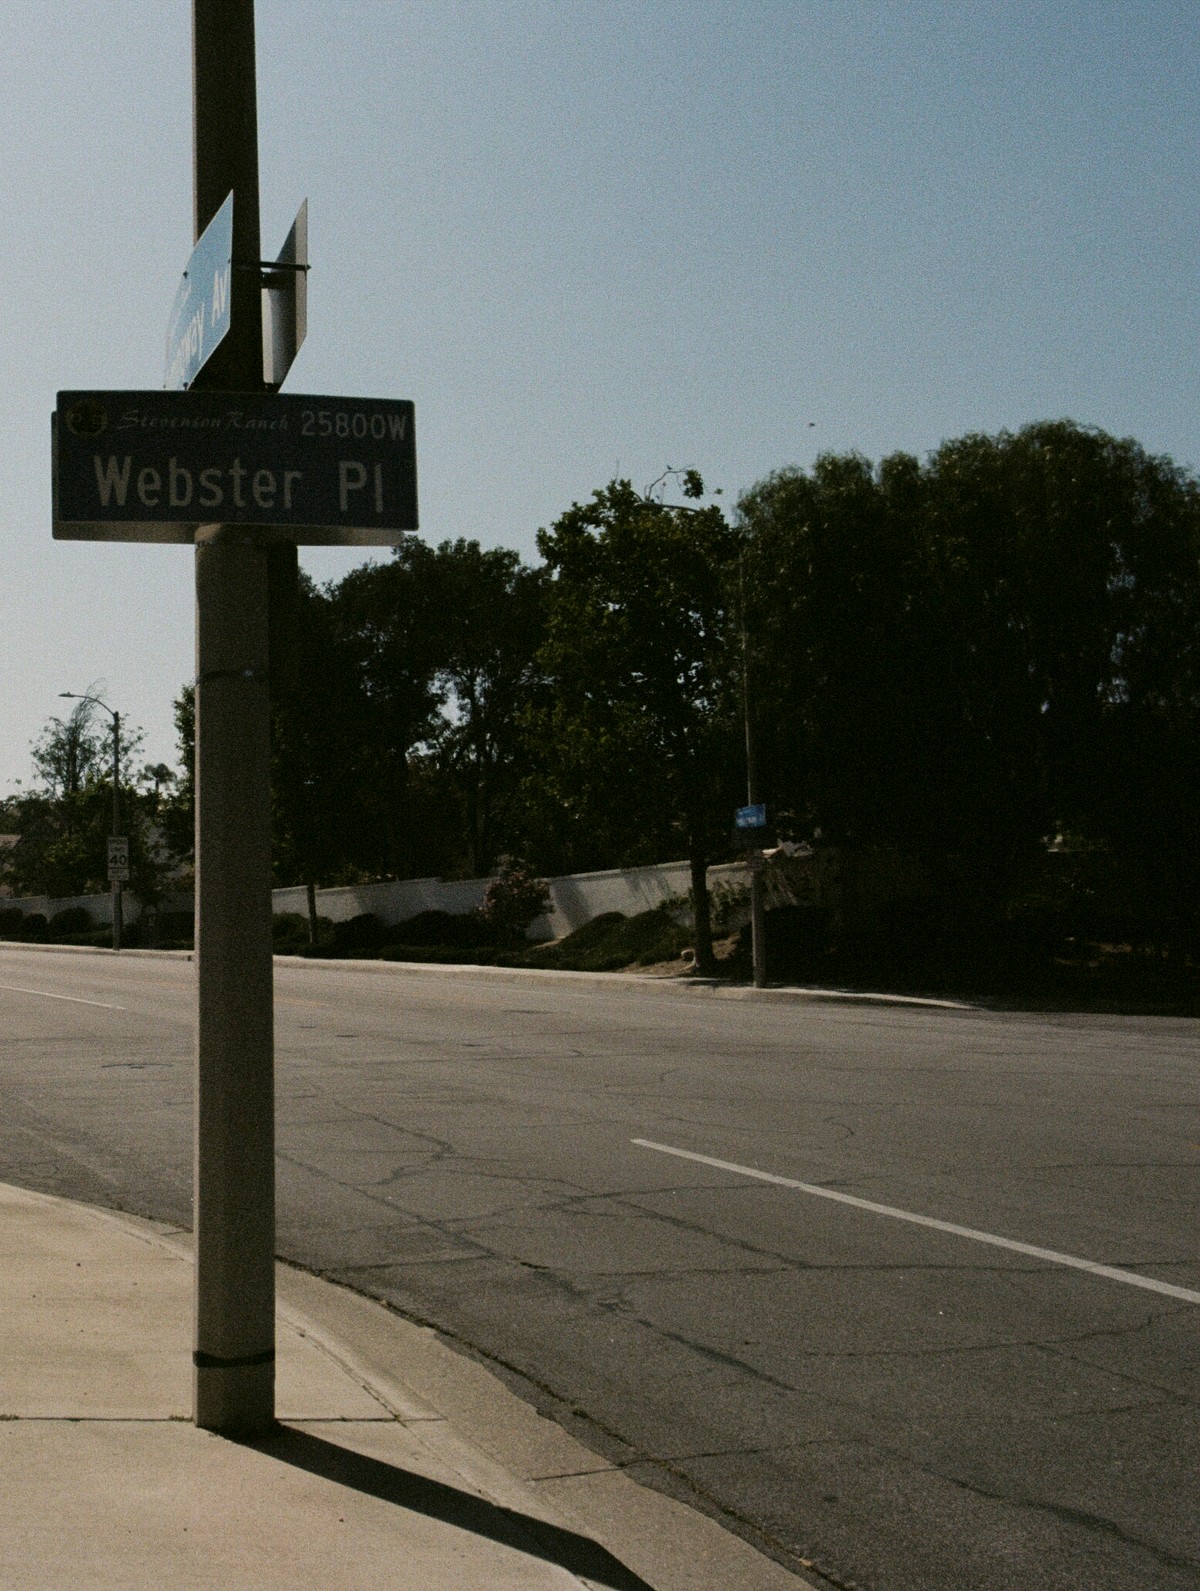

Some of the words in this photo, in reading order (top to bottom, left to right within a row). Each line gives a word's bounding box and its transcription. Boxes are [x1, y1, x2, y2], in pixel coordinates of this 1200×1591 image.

[225, 410, 289, 430] Ranch
[301, 409, 408, 441] 25800W
[93, 454, 304, 508] Webster
[338, 460, 384, 514] Pl
[109, 854, 127, 866] 40
